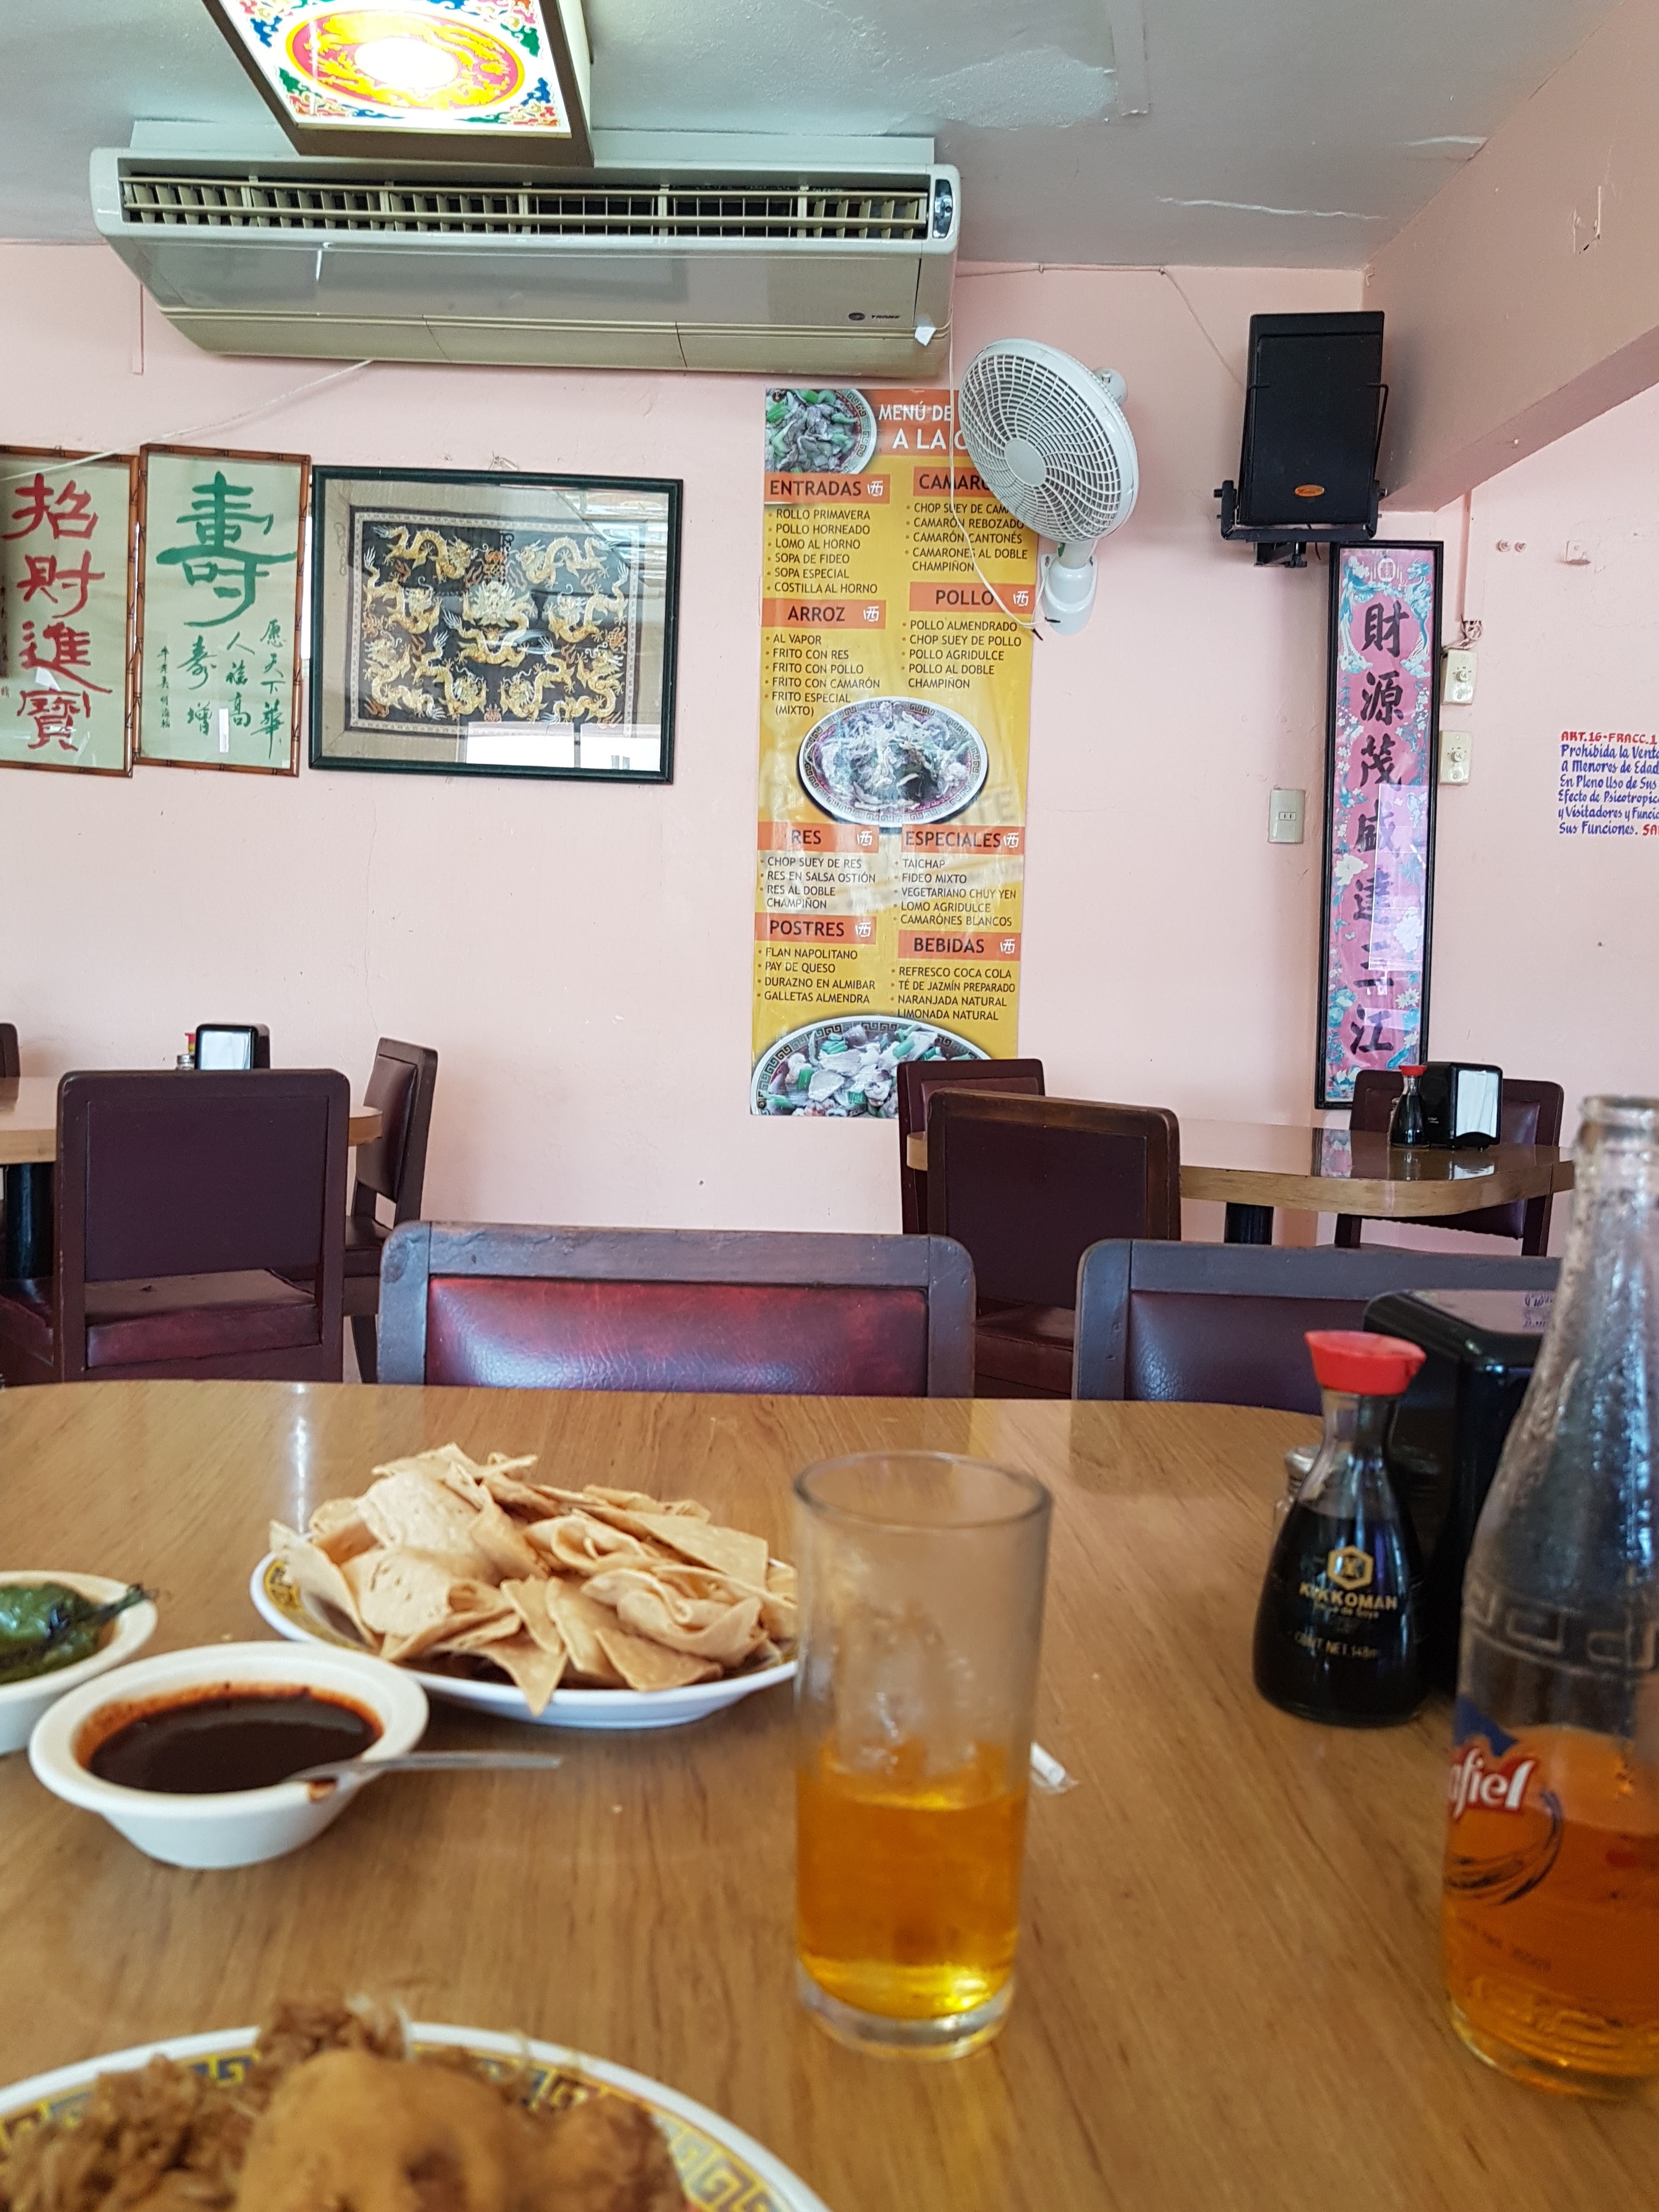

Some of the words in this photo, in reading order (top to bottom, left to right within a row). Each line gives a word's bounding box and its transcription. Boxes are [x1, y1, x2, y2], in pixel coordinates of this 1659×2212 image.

[879, 401, 926, 421] MENÚ
[933, 405, 951, 422] DE
[917, 429, 946, 450] LA
[771, 480, 861, 495] ENTRADAS
[777, 509, 810, 519] ROLLO
[814, 510, 871, 520] PRIMAVERA
[914, 503, 941, 512] CHOP
[944, 504, 967, 513] SUEY
[970, 504, 983, 514] DE
[913, 516, 964, 528] CAMARÓN
[969, 519, 1024, 529] REBOZADO
[776, 524, 810, 534] POLLO
[813, 524, 870, 535] HORNEADO
[913, 531, 964, 543] CAMARÓN
[969, 532, 1022, 544] CANTONÉS
[776, 539, 805, 549] LOMO
[808, 540, 820, 549] AL
[823, 539, 860, 550] HORNO
[775, 554, 800, 563] SOPA
[804, 554, 816, 563] DE
[820, 554, 850, 564] FIDEO
[913, 548, 975, 558] CAMARONES
[978, 549, 991, 558] AL
[995, 549, 1028, 559] DOBLE
[912, 560, 974, 572] CHAMPIÑON
[775, 568, 799, 578] SOPA
[803, 569, 849, 578] ESPECIAL
[775, 583, 822, 592] COSTILLA
[825, 583, 837, 592] AL
[840, 584, 877, 594] HORNO
[936, 591, 994, 605] POLLO
[1, 472, 112, 751] 招財進寶
[788, 607, 845, 622] ARROZ
[911, 620, 944, 631] POLLO
[947, 621, 1017, 632] ALMENDRADO
[773, 634, 785, 644] AL
[789, 635, 821, 645] VAPOR
[910, 635, 938, 645] CHOP
[942, 636, 967, 646] SUEY
[971, 636, 984, 646] DE
[988, 636, 1021, 647] POLLO
[773, 648, 802, 658] FRITO
[806, 649, 828, 659] CON
[831, 650, 849, 659] RES
[910, 650, 943, 660] POLLO
[946, 651, 1004, 661] AGRIDULCE
[773, 663, 802, 673] FRITO
[805, 664, 827, 674] CON
[831, 664, 864, 674] POLLO
[909, 664, 943, 674] POLLO
[945, 664, 958, 674] AL
[962, 664, 995, 675] DOBLE
[772, 678, 802, 687] FRITO
[805, 678, 827, 688] CON
[830, 676, 879, 689] CAMARÓN
[909, 677, 970, 689] CHAMPIÑON
[772, 692, 801, 702] FRITO
[805, 692, 850, 703] ESPECIAL
[775, 706, 814, 718] (MIXTO)
[1561, 743, 1617, 758] Prohibida
[1620, 744, 1629, 758] la
[1572, 760, 1618, 773] Menores
[1620, 760, 1632, 774] de
[1635, 760, 1659, 774] Edad
[1560, 774, 1574, 787] En
[1577, 775, 1604, 788] Pleno
[1606, 776, 1623, 788] Uso
[1626, 776, 1638, 789] de
[1640, 777, 1656, 789] Sus
[1558, 789, 1587, 804] Efecto
[1590, 789, 1601, 802] de
[1604, 791, 1659, 806] Psicotropic
[1558, 809, 1564, 820] y
[1566, 805, 1622, 818] Visitadores
[1625, 811, 1630, 822] y
[1559, 822, 1577, 834] Sus
[1582, 821, 1638, 835] Funciones.
[1643, 824, 1659, 836] SA
[792, 830, 821, 844] RES
[906, 831, 1001, 848] ESPECIALES
[768, 857, 795, 867] CHOP
[799, 857, 823, 868] SUEY
[828, 859, 840, 868] DE
[844, 859, 861, 868] RES
[902, 859, 945, 868] TAICHAP
[768, 872, 786, 881] RES
[789, 872, 802, 882] EN
[806, 872, 835, 882] SALSA
[838, 872, 876, 883] OSTIÓN
[902, 873, 932, 883] FIDEO
[935, 873, 967, 884] MIXTO
[768, 885, 785, 895] RES
[788, 886, 800, 895] AL
[804, 886, 836, 896] DOBLE
[902, 887, 966, 898] VEGETARIANO
[969, 888, 996, 899] CHUY
[999, 889, 1017, 899] YEN
[767, 896, 827, 909] CHAMPIÑON
[901, 901, 930, 911] LOMO
[933, 902, 990, 912] AGRIDULCE
[900, 913, 962, 926] CAMARÓNES
[966, 916, 1012, 927] BLANCOS
[770, 920, 844, 936] POSTRES
[914, 938, 984, 953] BEBIDAS
[766, 948, 791, 957] FLAN
[794, 949, 857, 960] NAPOLITANO
[765, 962, 782, 971] PAY
[786, 962, 798, 972] DE
[802, 963, 835, 974] QUESO
[900, 967, 950, 977] REFRESCO
[954, 968, 981, 978] COCA
[985, 968, 1011, 978] COLA
[765, 977, 812, 988] DURAZNO
[817, 979, 829, 988] EN
[832, 979, 875, 989] ALMIBAR
[899, 979, 910, 990] TÉ
[913, 981, 924, 991] DE
[927, 980, 960, 991] JAZMÍN
[963, 982, 1015, 992] PREPARADO
[764, 991, 813, 1002] GALLETAS
[815, 992, 870, 1003] ALMENDRA
[898, 995, 958, 1005] NARANJADA
[962, 996, 1007, 1006] NATURAL
[898, 1009, 950, 1019] LIMONADA
[953, 1010, 998, 1020] NATURAL
